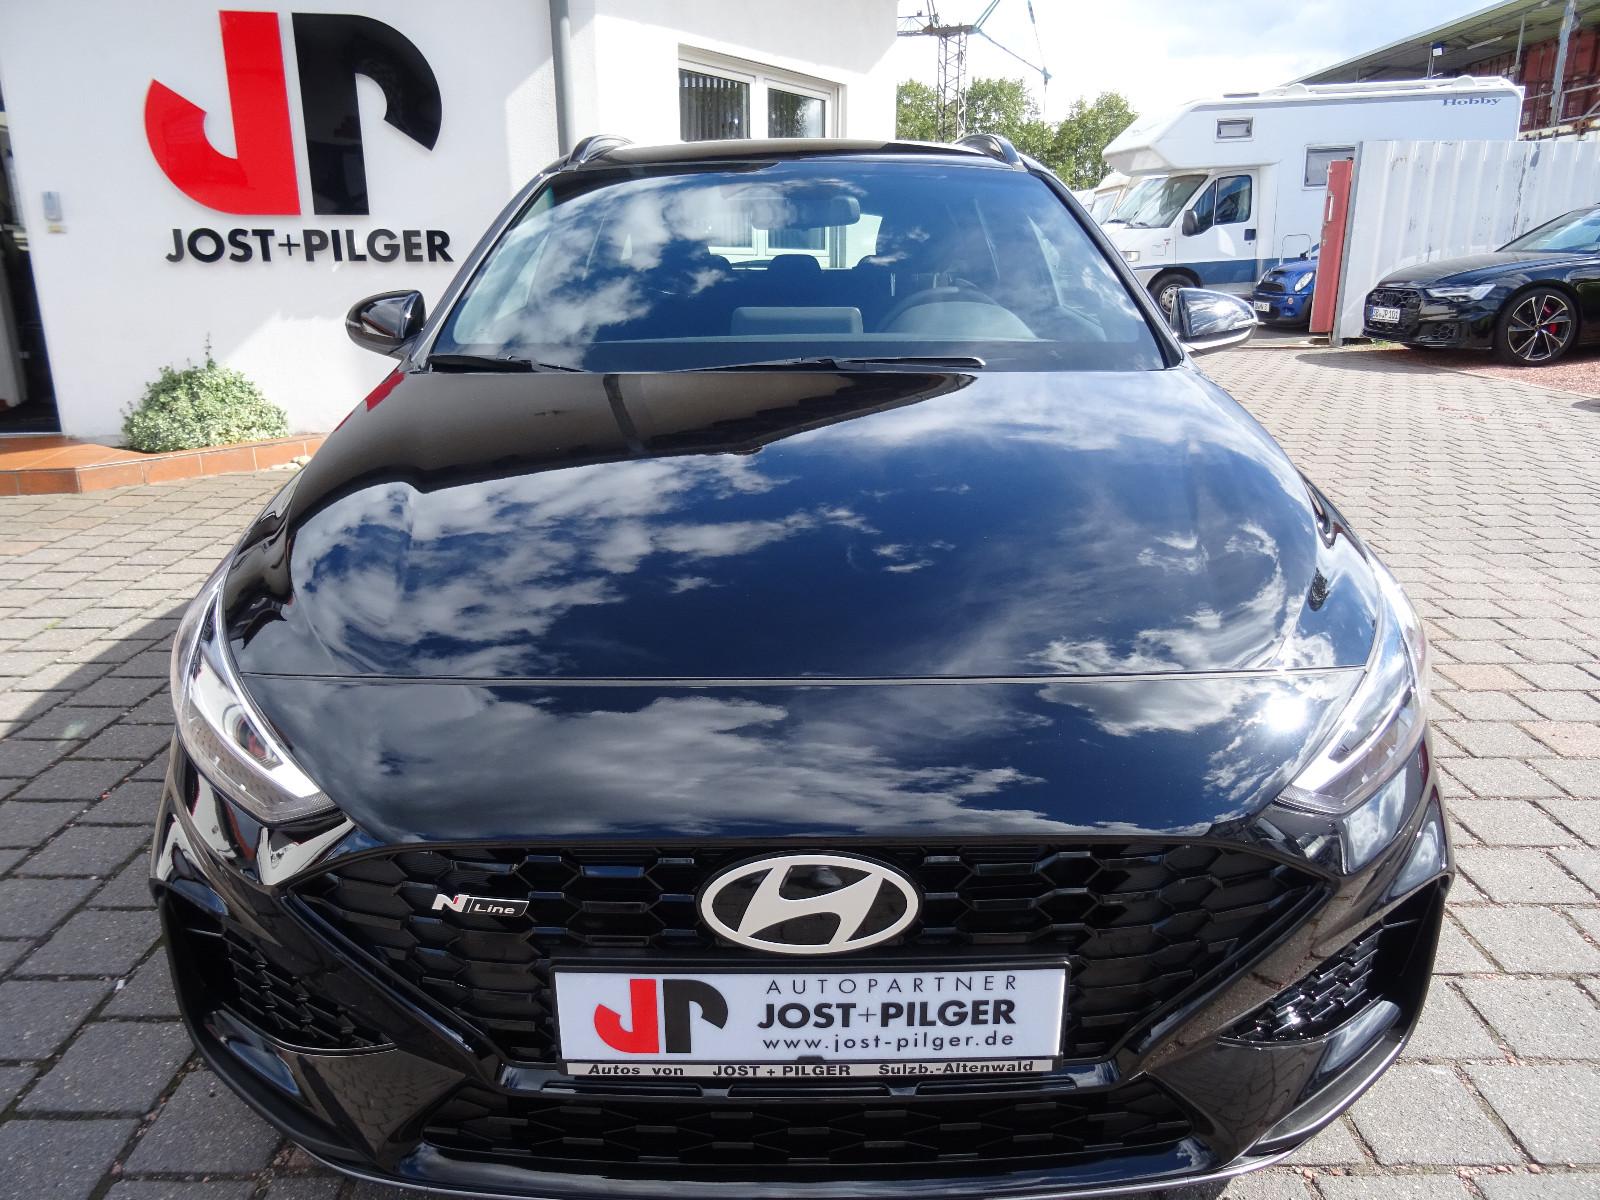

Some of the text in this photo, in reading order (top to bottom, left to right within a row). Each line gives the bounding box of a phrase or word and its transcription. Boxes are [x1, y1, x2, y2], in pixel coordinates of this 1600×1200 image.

[1443, 96, 1502, 106] Hobby
[165, 227, 455, 263] JOST+PILGER
[473, 903, 516, 915] Line
[766, 974, 1017, 995] AUTOPARTNER
[757, 999, 1017, 1030] JOST+PILGER
[762, 1030, 1015, 1053] www.jost-pilger.de
[588, 1063, 641, 1076] Autos
[652, 1066, 685, 1077] von
[712, 1065, 761, 1078] JOST
[782, 1064, 851, 1077] PILGER
[877, 1060, 1035, 1076] Sulzb.-Altenwald
